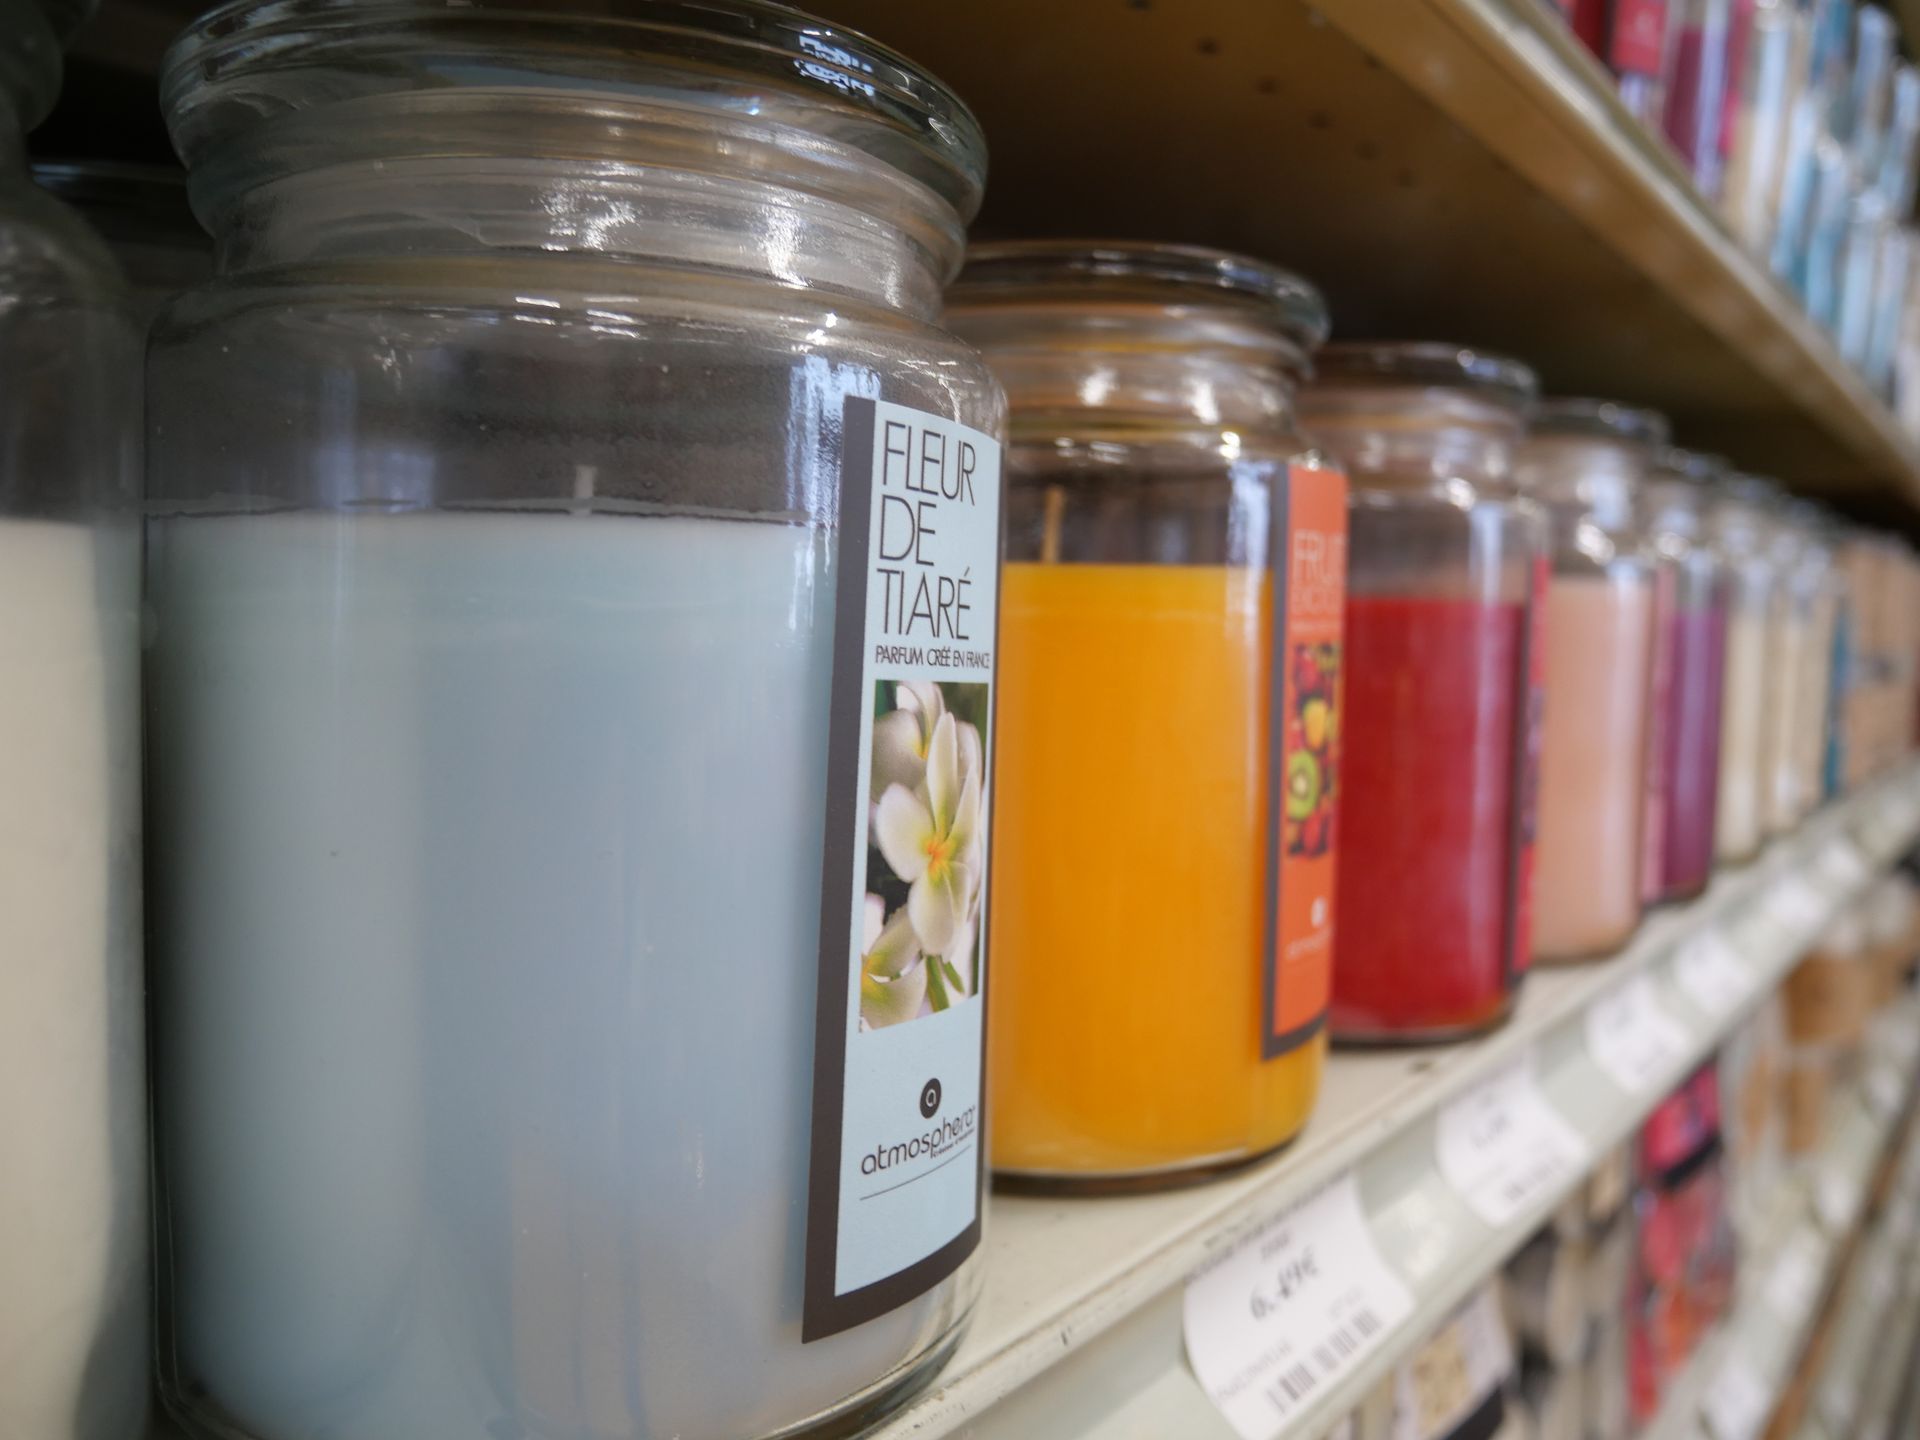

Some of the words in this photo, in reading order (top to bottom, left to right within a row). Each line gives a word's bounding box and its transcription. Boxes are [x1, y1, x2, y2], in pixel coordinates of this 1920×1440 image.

[882, 420, 976, 507] FLEUR
[878, 493, 937, 567] DE
[876, 566, 972, 641] TIARÉ
[875, 644, 924, 666] PARFUM
[952, 650, 965, 669] EN
[966, 650, 990, 669] FRANCE
